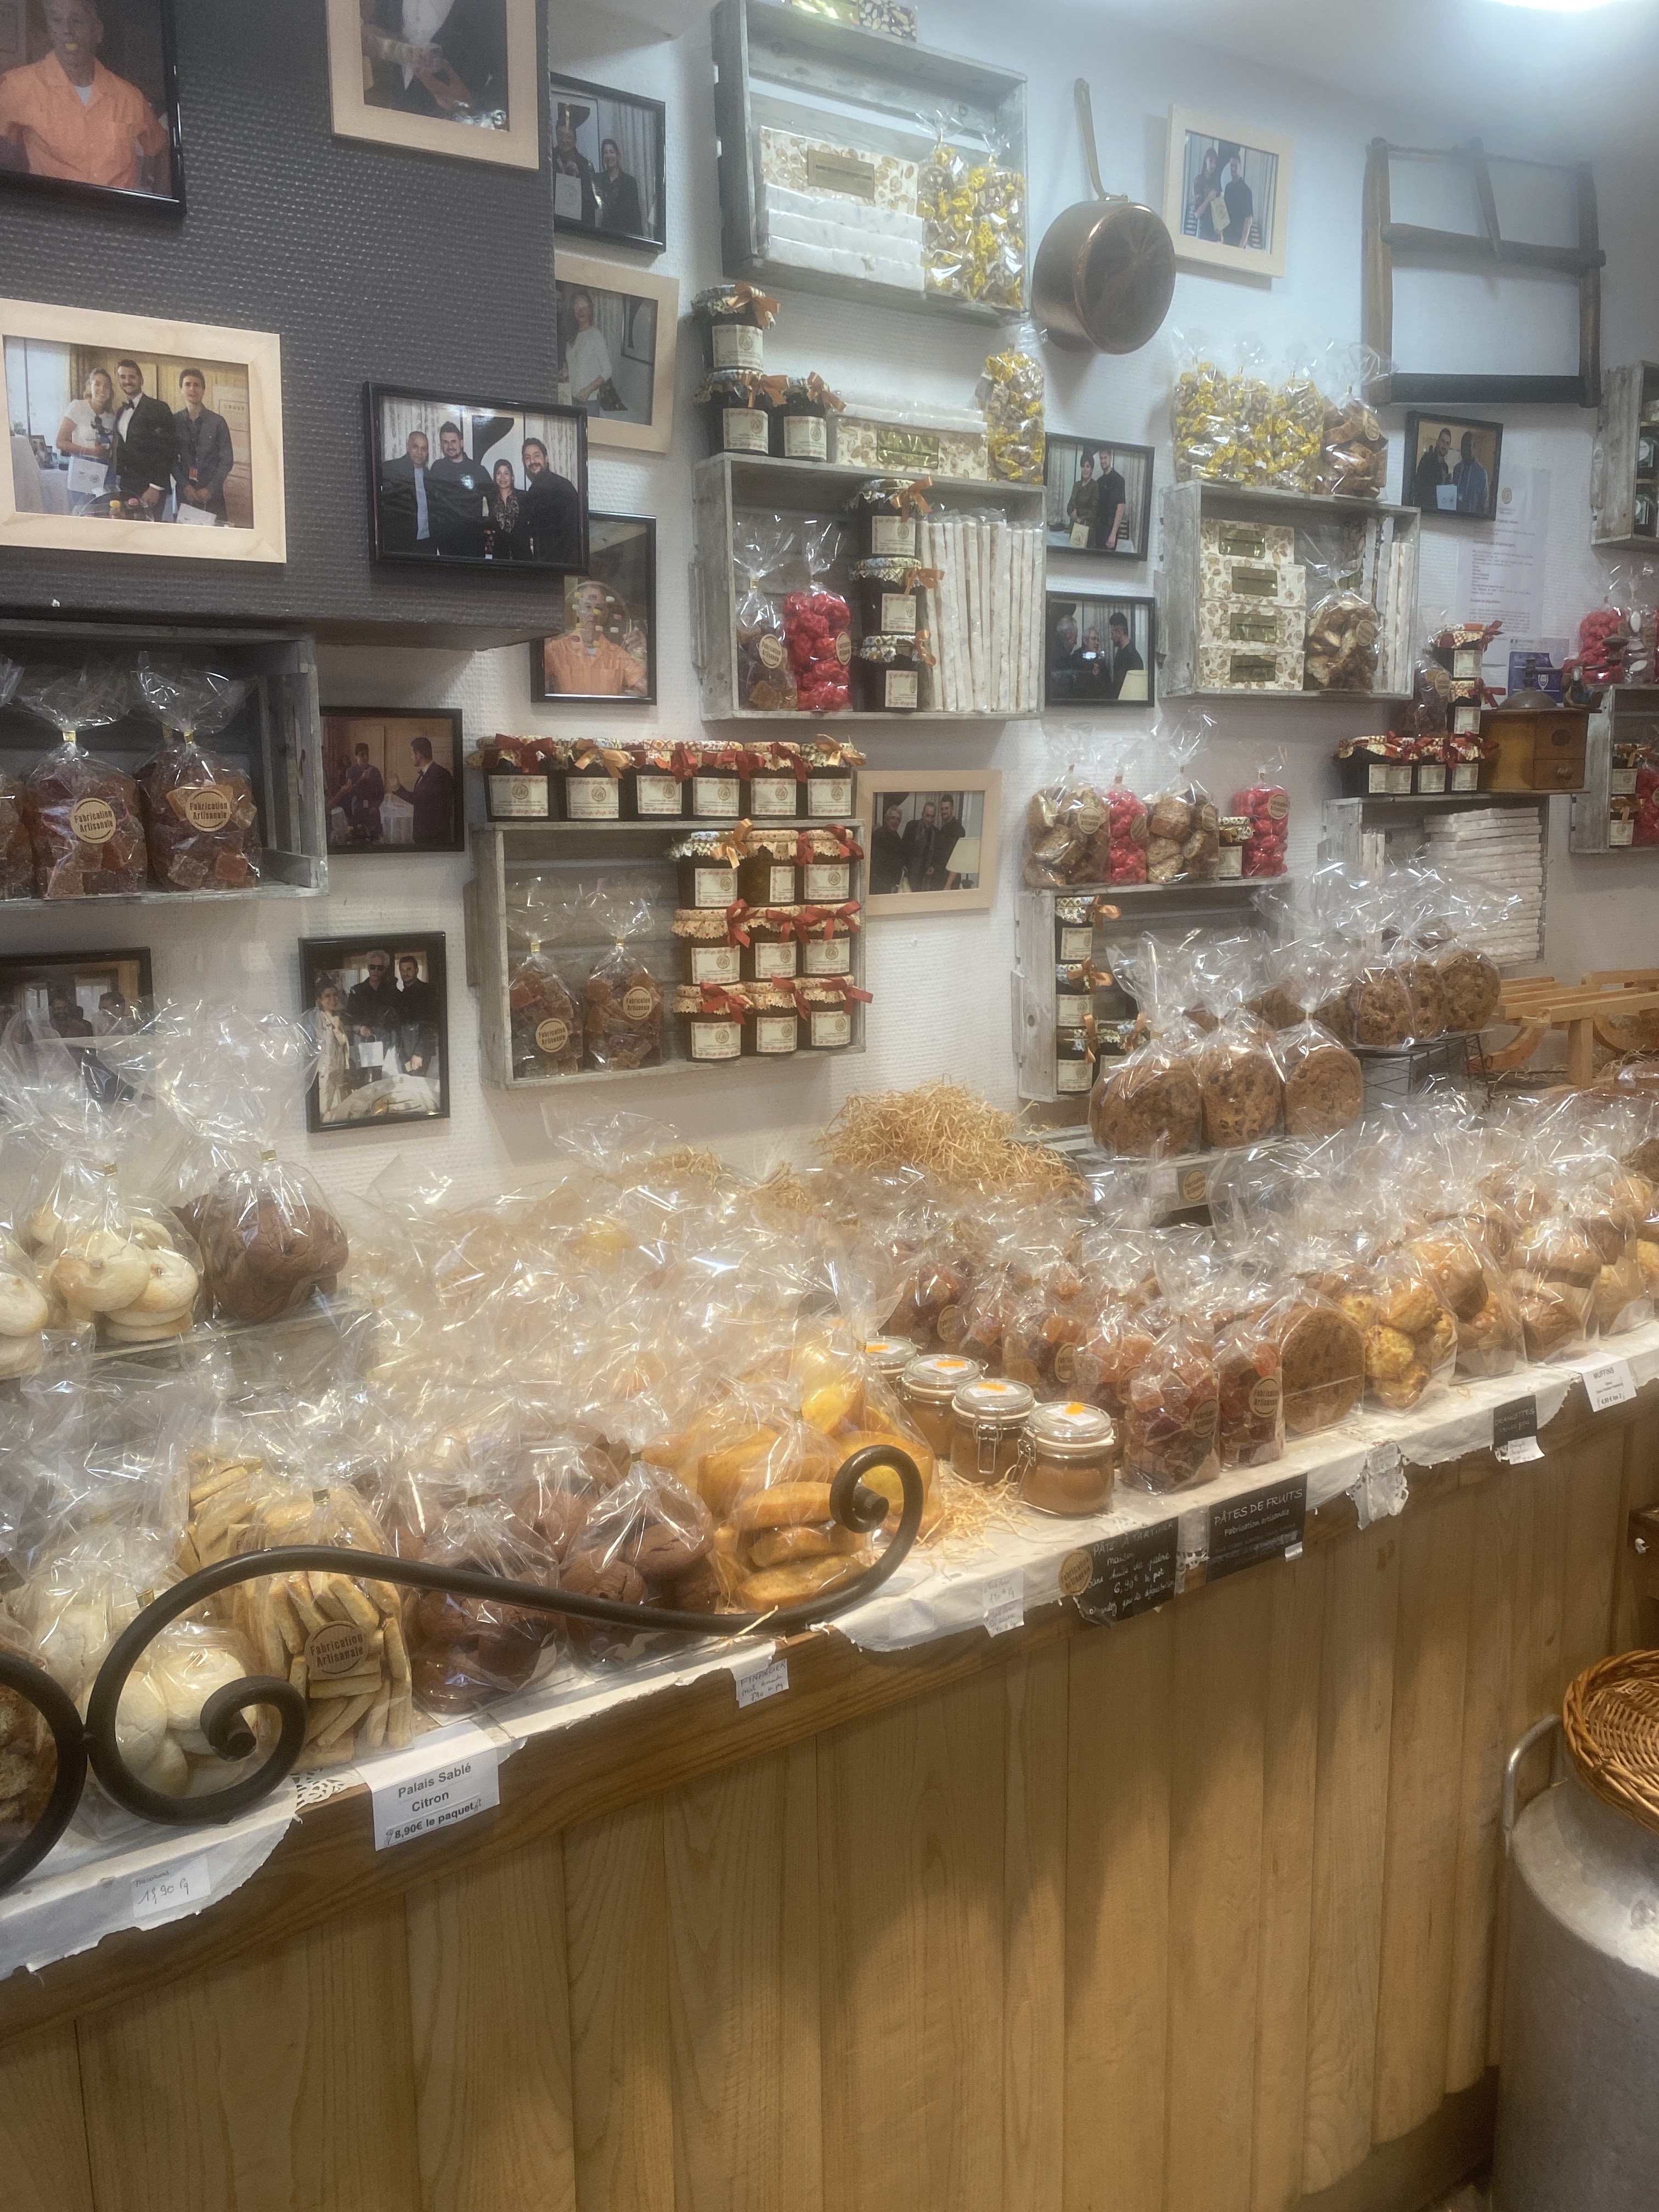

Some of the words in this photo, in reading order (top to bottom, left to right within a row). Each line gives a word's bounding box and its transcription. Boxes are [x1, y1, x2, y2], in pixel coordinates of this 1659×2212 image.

[74, 810, 112, 823] Fabrication
[189, 802, 228, 811] Fabrication
[193, 811, 227, 820] Artisanale
[80, 820, 113, 833] Artisanale
[1593, 1367, 1615, 1379] MUFFINS
[1250, 1500, 1265, 1514] DE
[1266, 1488, 1303, 1509] FRUITS
[309, 1634, 363, 1656] Fabrication
[317, 1646, 363, 1667] Artisanale
[741, 1660, 786, 1688] FINANCIER
[398, 1778, 435, 1798] Palais
[438, 1762, 471, 1783] Sablé
[411, 1791, 449, 1812] Citron
[394, 1821, 423, 1839] 8,90€
[426, 1818, 435, 1827] le
[438, 1802, 474, 1825] paquet
